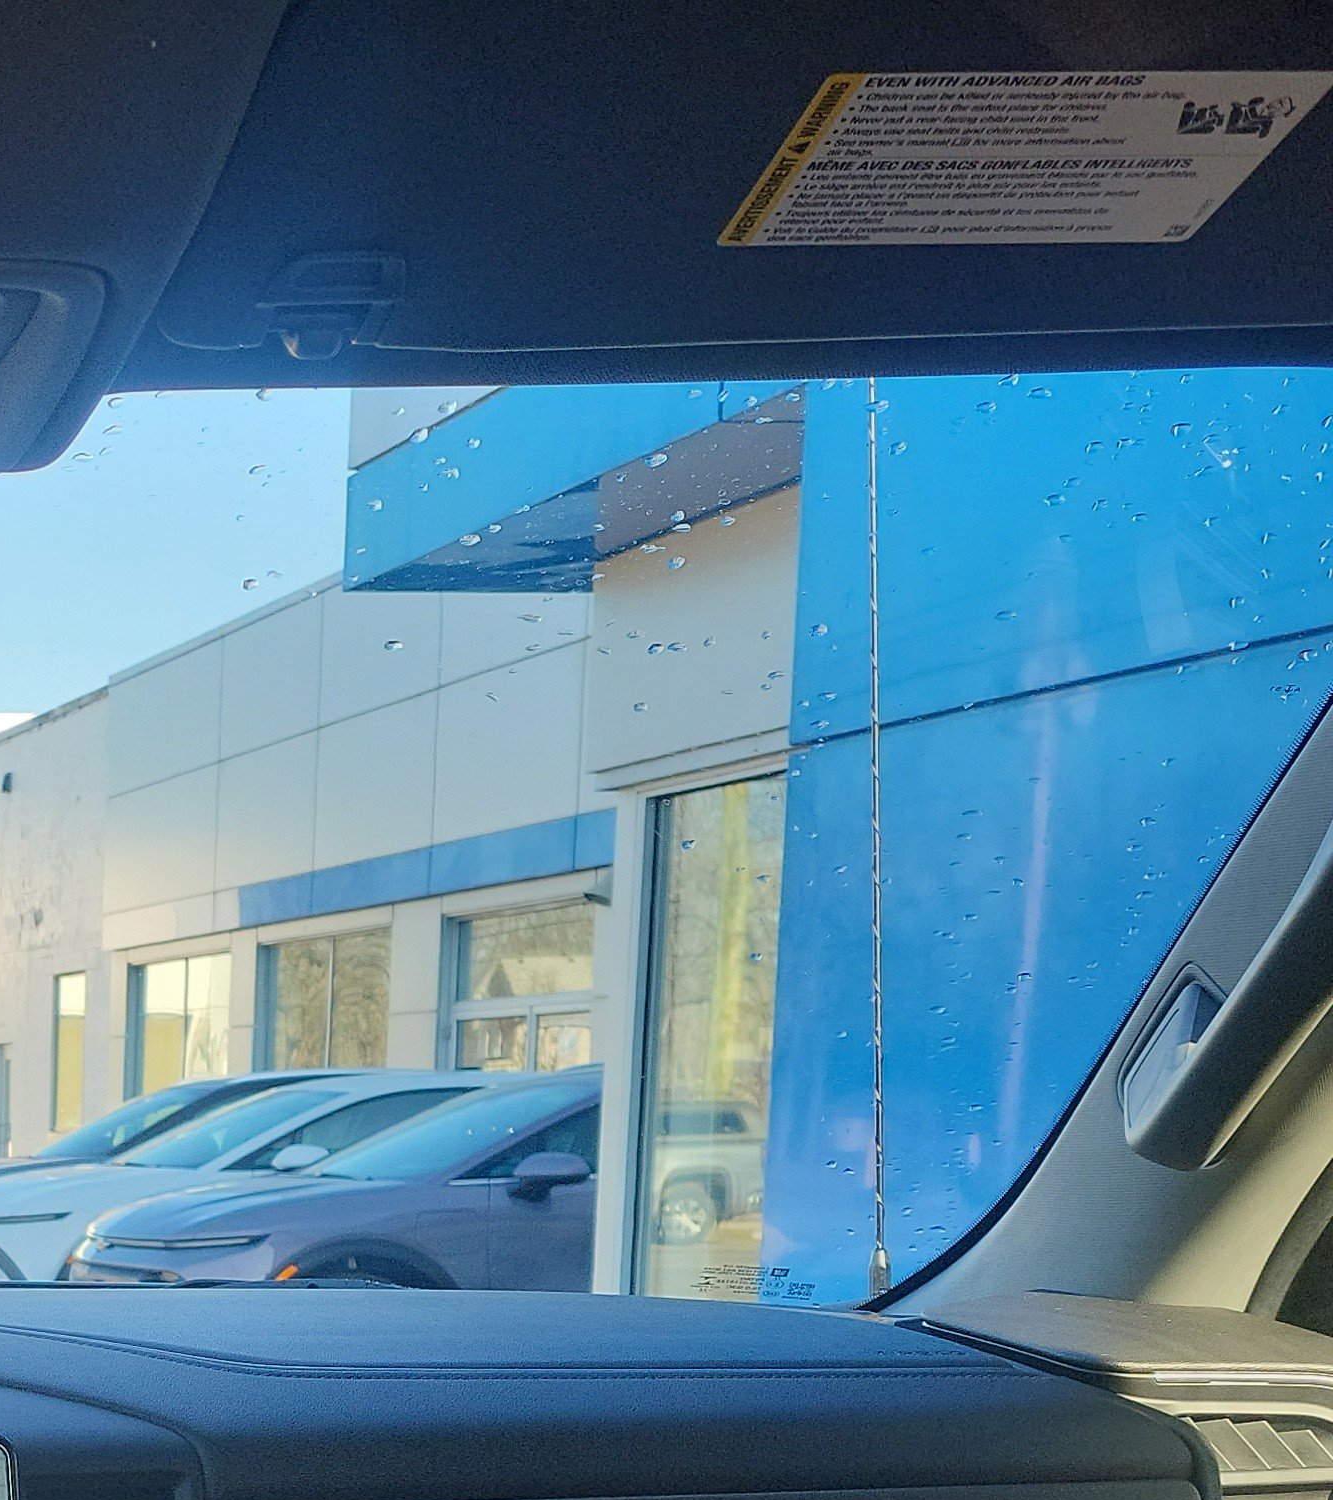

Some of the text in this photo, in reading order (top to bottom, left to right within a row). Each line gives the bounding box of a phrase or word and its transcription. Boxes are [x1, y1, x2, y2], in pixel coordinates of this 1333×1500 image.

[865, 75, 1146, 87] EVEN WITH ADVANCED AIR BAGS
[807, 158, 1193, 171] MÊME AVEC DES SACS GONFLABLES INTELLIGENTS
